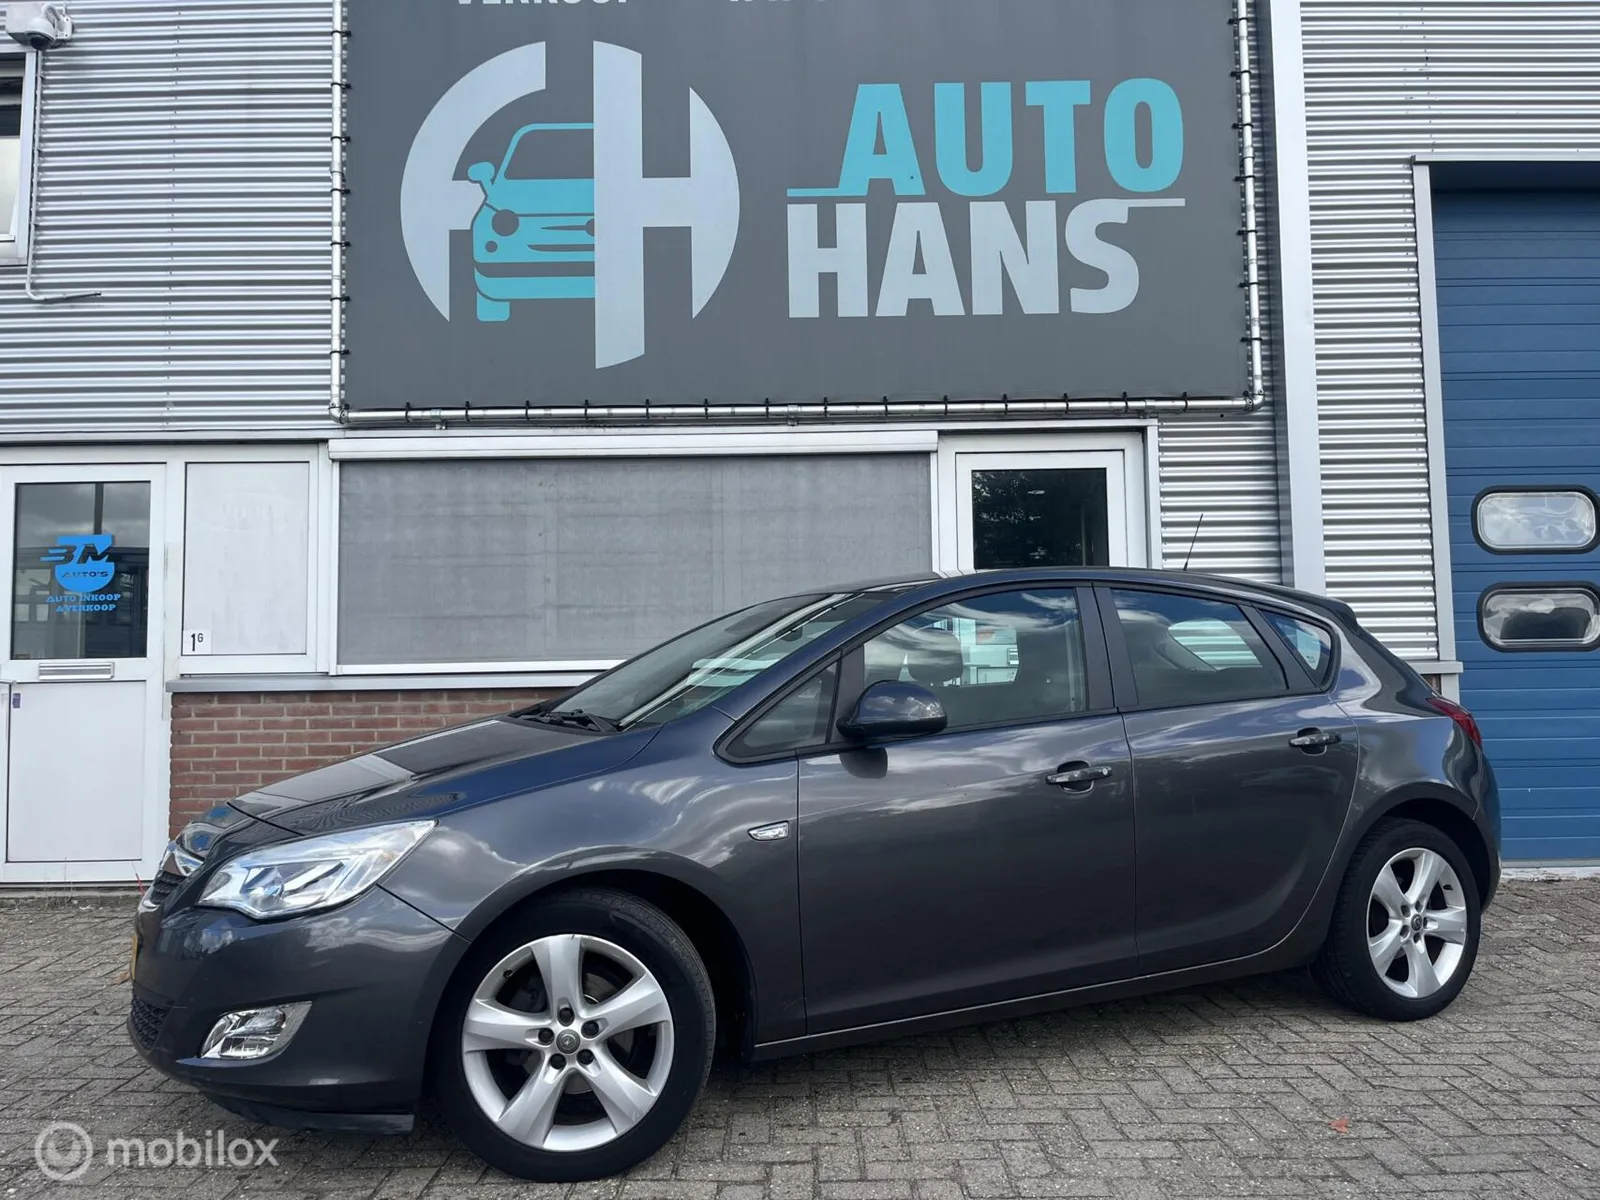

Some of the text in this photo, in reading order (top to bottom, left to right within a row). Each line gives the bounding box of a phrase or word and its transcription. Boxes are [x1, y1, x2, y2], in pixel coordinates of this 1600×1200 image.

[787, 77, 1184, 196] AUTO
[787, 198, 1186, 318] HANS
[46, 593, 121, 603] AUTO INKOOP
